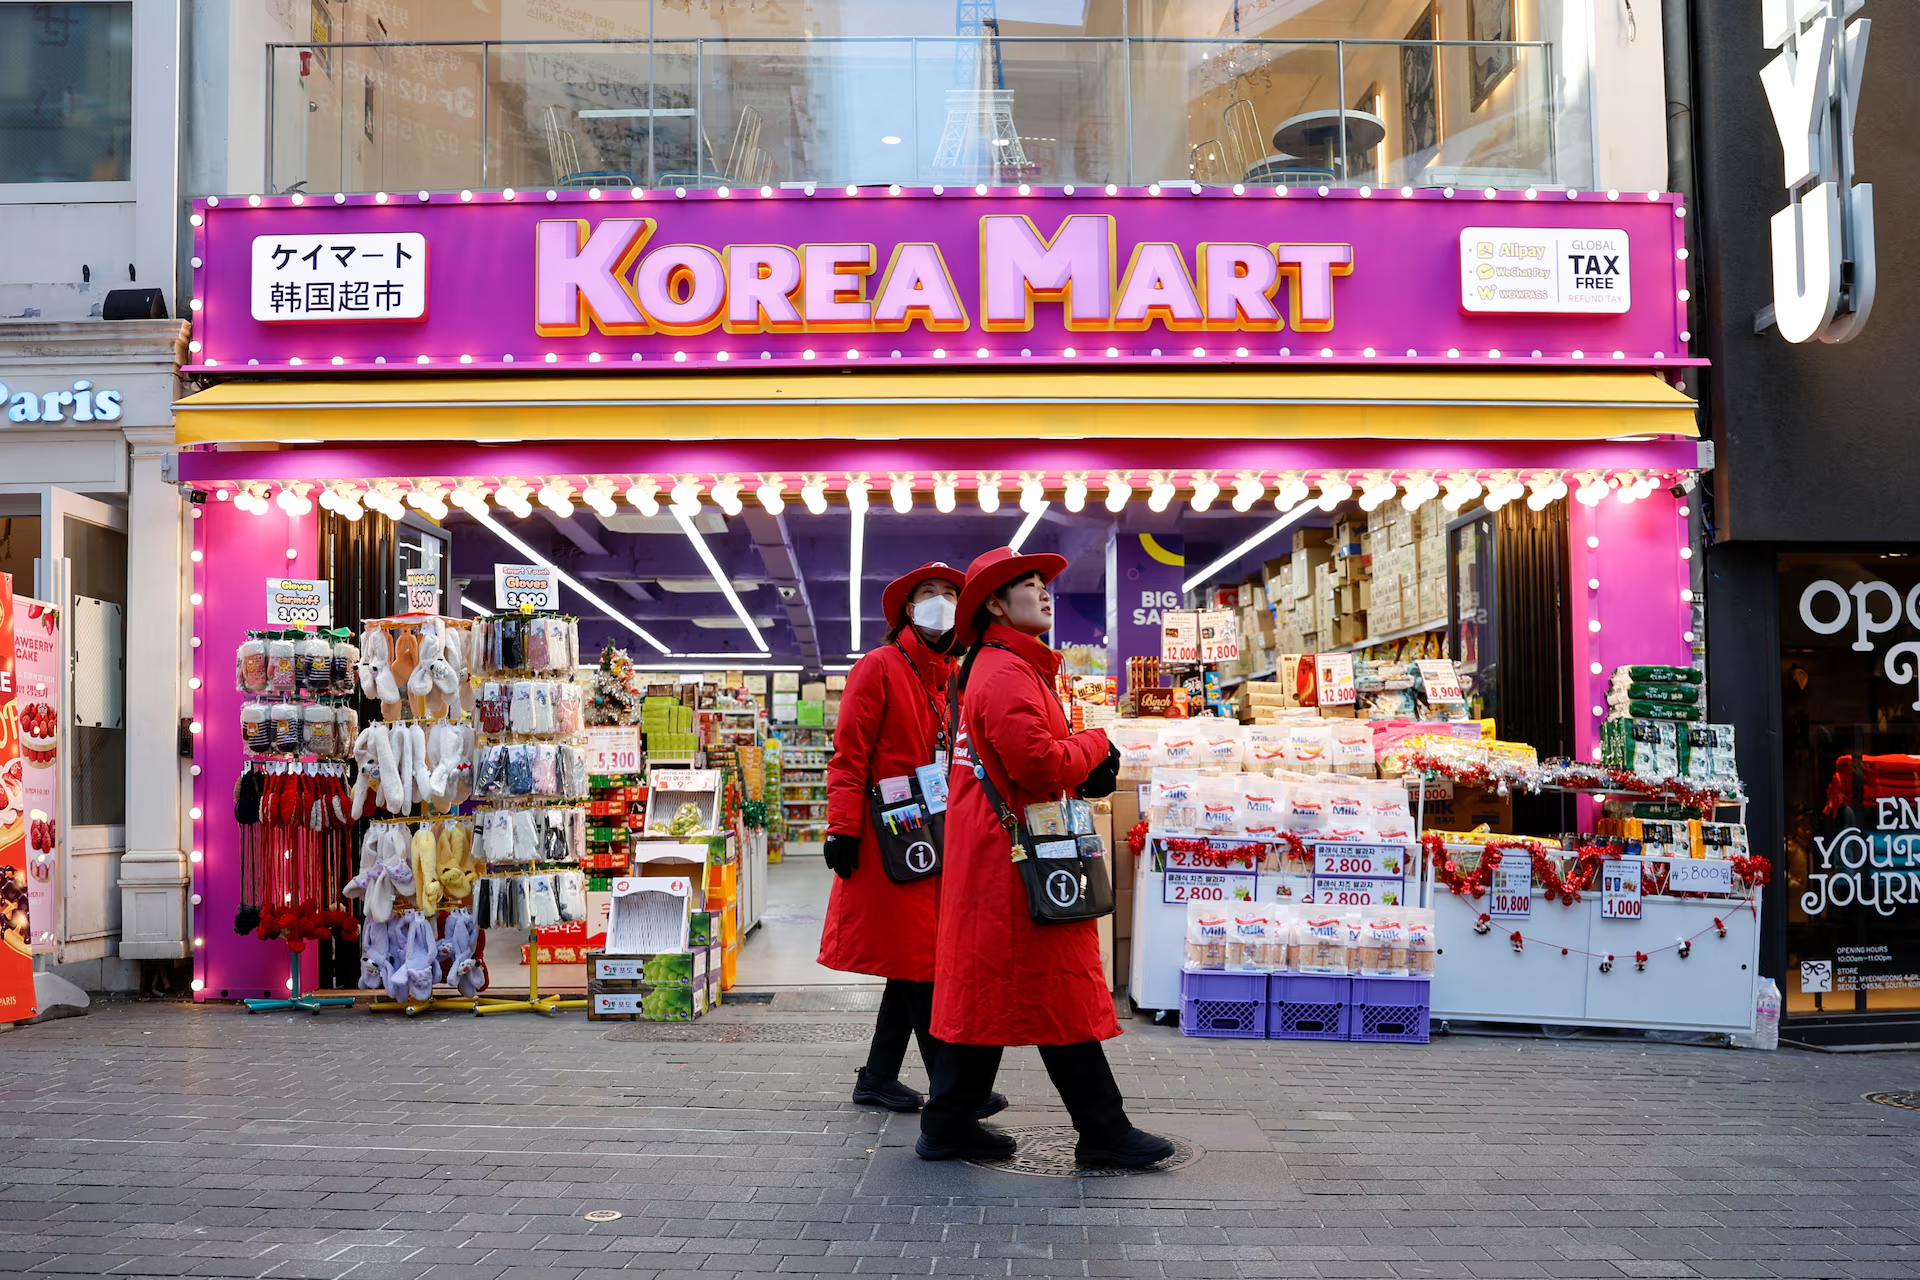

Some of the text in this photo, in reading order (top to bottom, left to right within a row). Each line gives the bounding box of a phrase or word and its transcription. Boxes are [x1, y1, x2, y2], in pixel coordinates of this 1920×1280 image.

[1498, 243, 1546, 260] Alipay
[1571, 240, 1616, 251] GLOBAL
[271, 242, 412, 271] ケイマート
[1568, 255, 1620, 275] TAX
[536, 214, 1353, 336] KOREA MART
[1496, 267, 1551, 279] WeChat Pay
[1576, 277, 1614, 289] FREE
[270, 280, 404, 313] 韩国超市
[1499, 290, 1548, 300] WOWPASS
[1568, 294, 1622, 303] REFUND TAX
[503, 567, 525, 575] Smart
[281, 580, 314, 591] Gloves
[506, 576, 548, 589] Gloves
[275, 593, 320, 605] Earmuff
[507, 592, 548, 607] 3,900
[1141, 591, 1177, 608] BIG
[278, 607, 319, 622] 3,000
[1133, 609, 1163, 626] SA
[15, 636, 54, 653] AWBERRY
[15, 648, 38, 662] CAKE
[1167, 647, 1197, 662] 12,000
[1207, 645, 1237, 663] 7,800
[1431, 687, 1461, 699] 8,900
[1141, 693, 1171, 707] Binch
[1167, 748, 1190, 756] Milk
[599, 752, 635, 771] 5,300
[1247, 801, 1273, 812] Milk
[1332, 806, 1359, 816] Milk
[1206, 812, 1232, 822] Milk
[1325, 858, 1372, 873] 2,800
[1175, 886, 1223, 901] 2,800
[1324, 892, 1371, 905] 2,800
[1496, 895, 1529, 914] 10,800
[1607, 899, 1641, 918] 1,000
[1201, 926, 1226, 936] Milk
[1237, 925, 1265, 935] Milk
[1310, 927, 1338, 937] Milk
[1373, 930, 1400, 940] Milk
[1409, 932, 1425, 942] ilk
[1837, 947, 1865, 955] OPENING
[1837, 967, 1858, 975] STORE
[1860, 974, 1903, 983] MYEONGDONG
[1885, 981, 1908, 989] SOUTH
